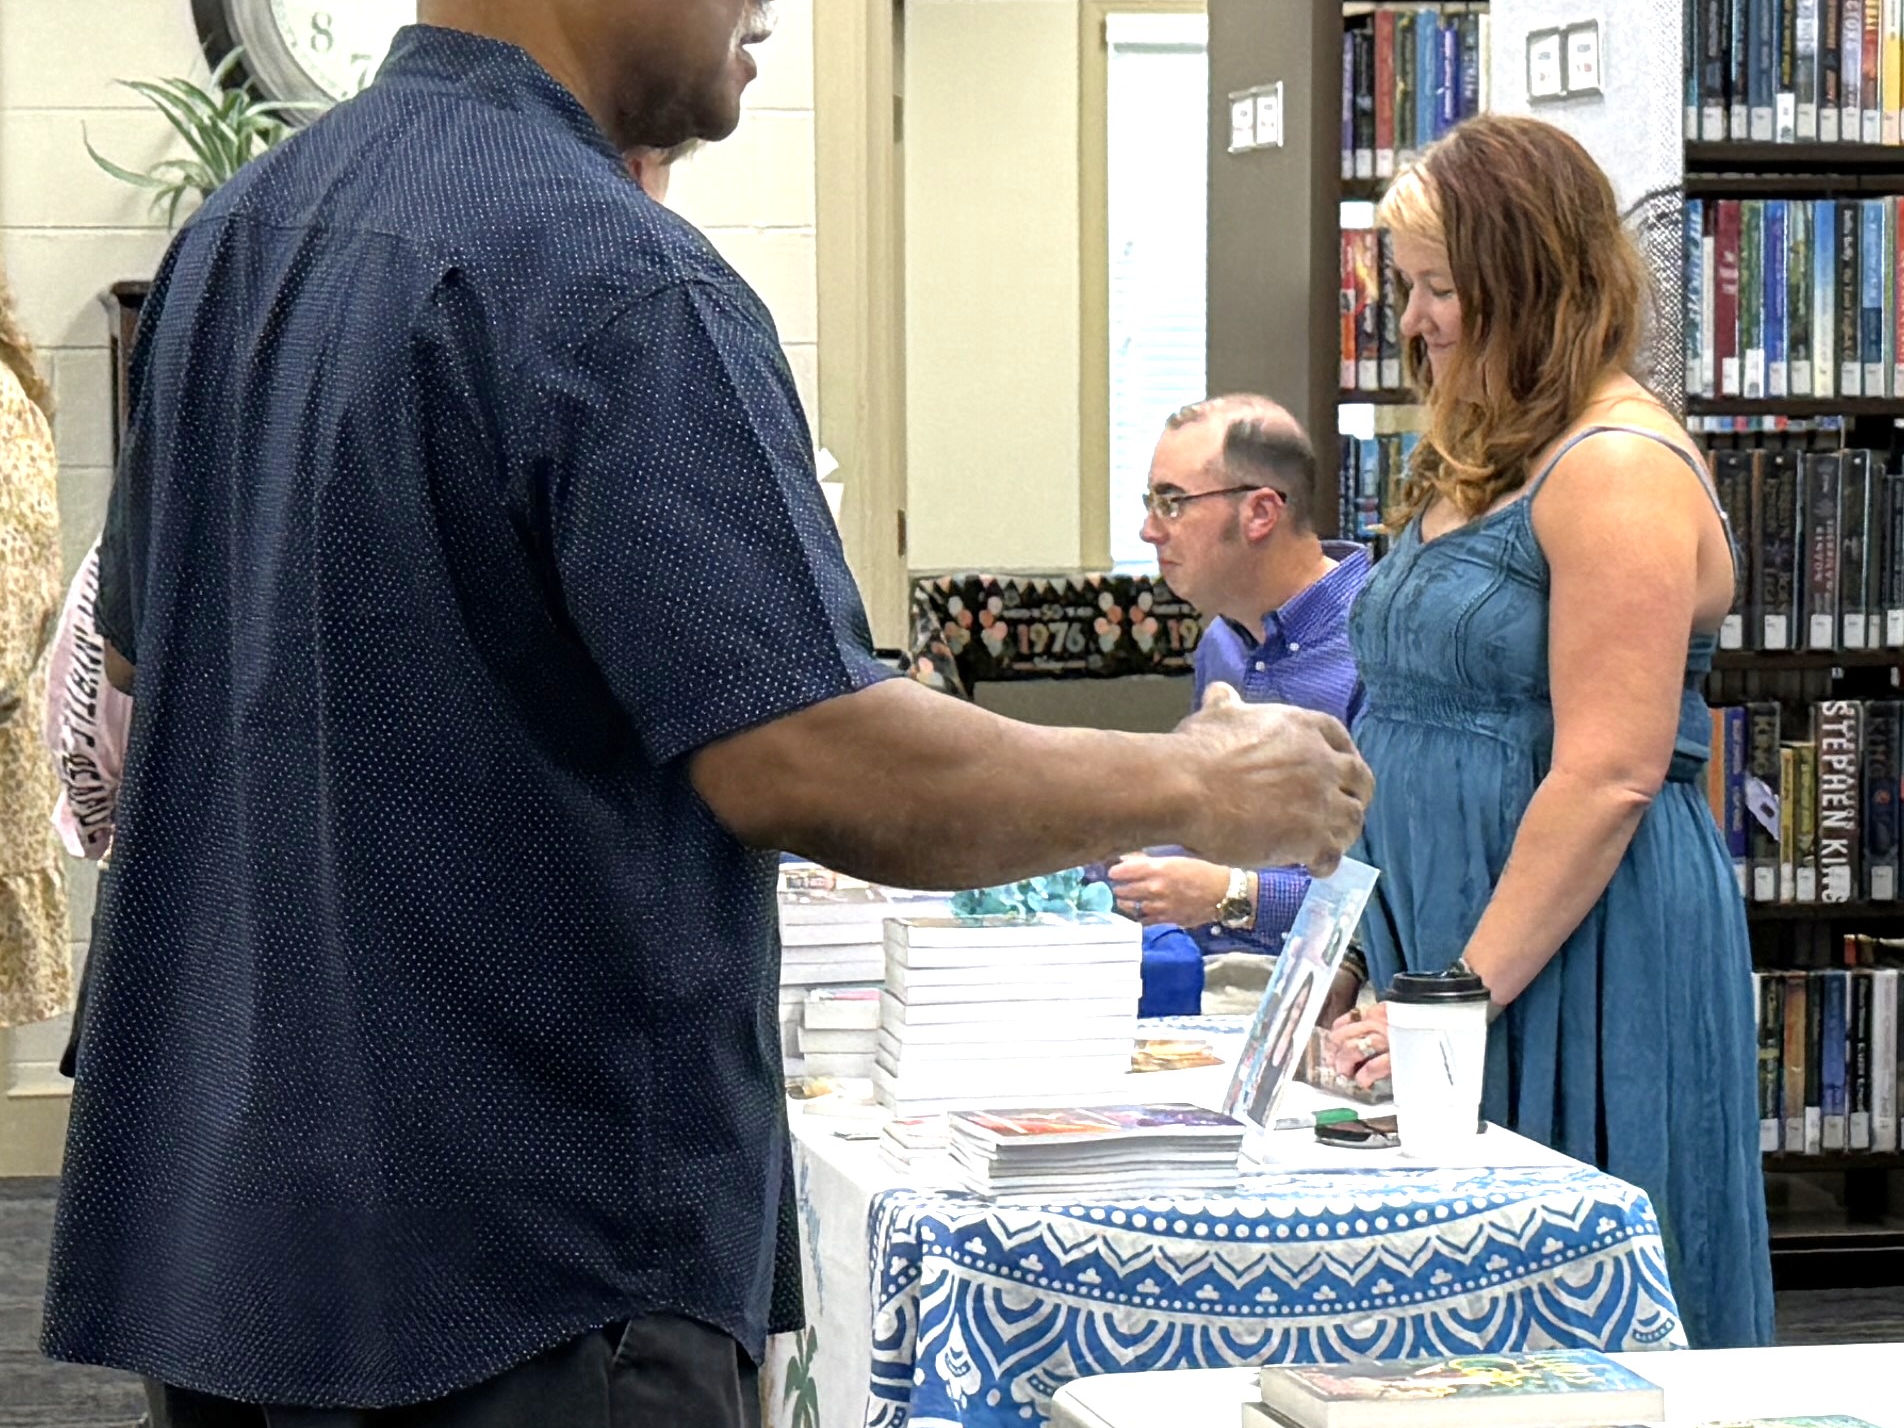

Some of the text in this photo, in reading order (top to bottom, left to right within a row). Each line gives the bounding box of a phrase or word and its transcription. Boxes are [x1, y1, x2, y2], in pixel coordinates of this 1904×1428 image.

[309, 12, 334, 53] 8
[350, 53, 373, 89] 7
[1017, 621, 1086, 655] 1976
[1822, 702, 1848, 829] STEPHEN
